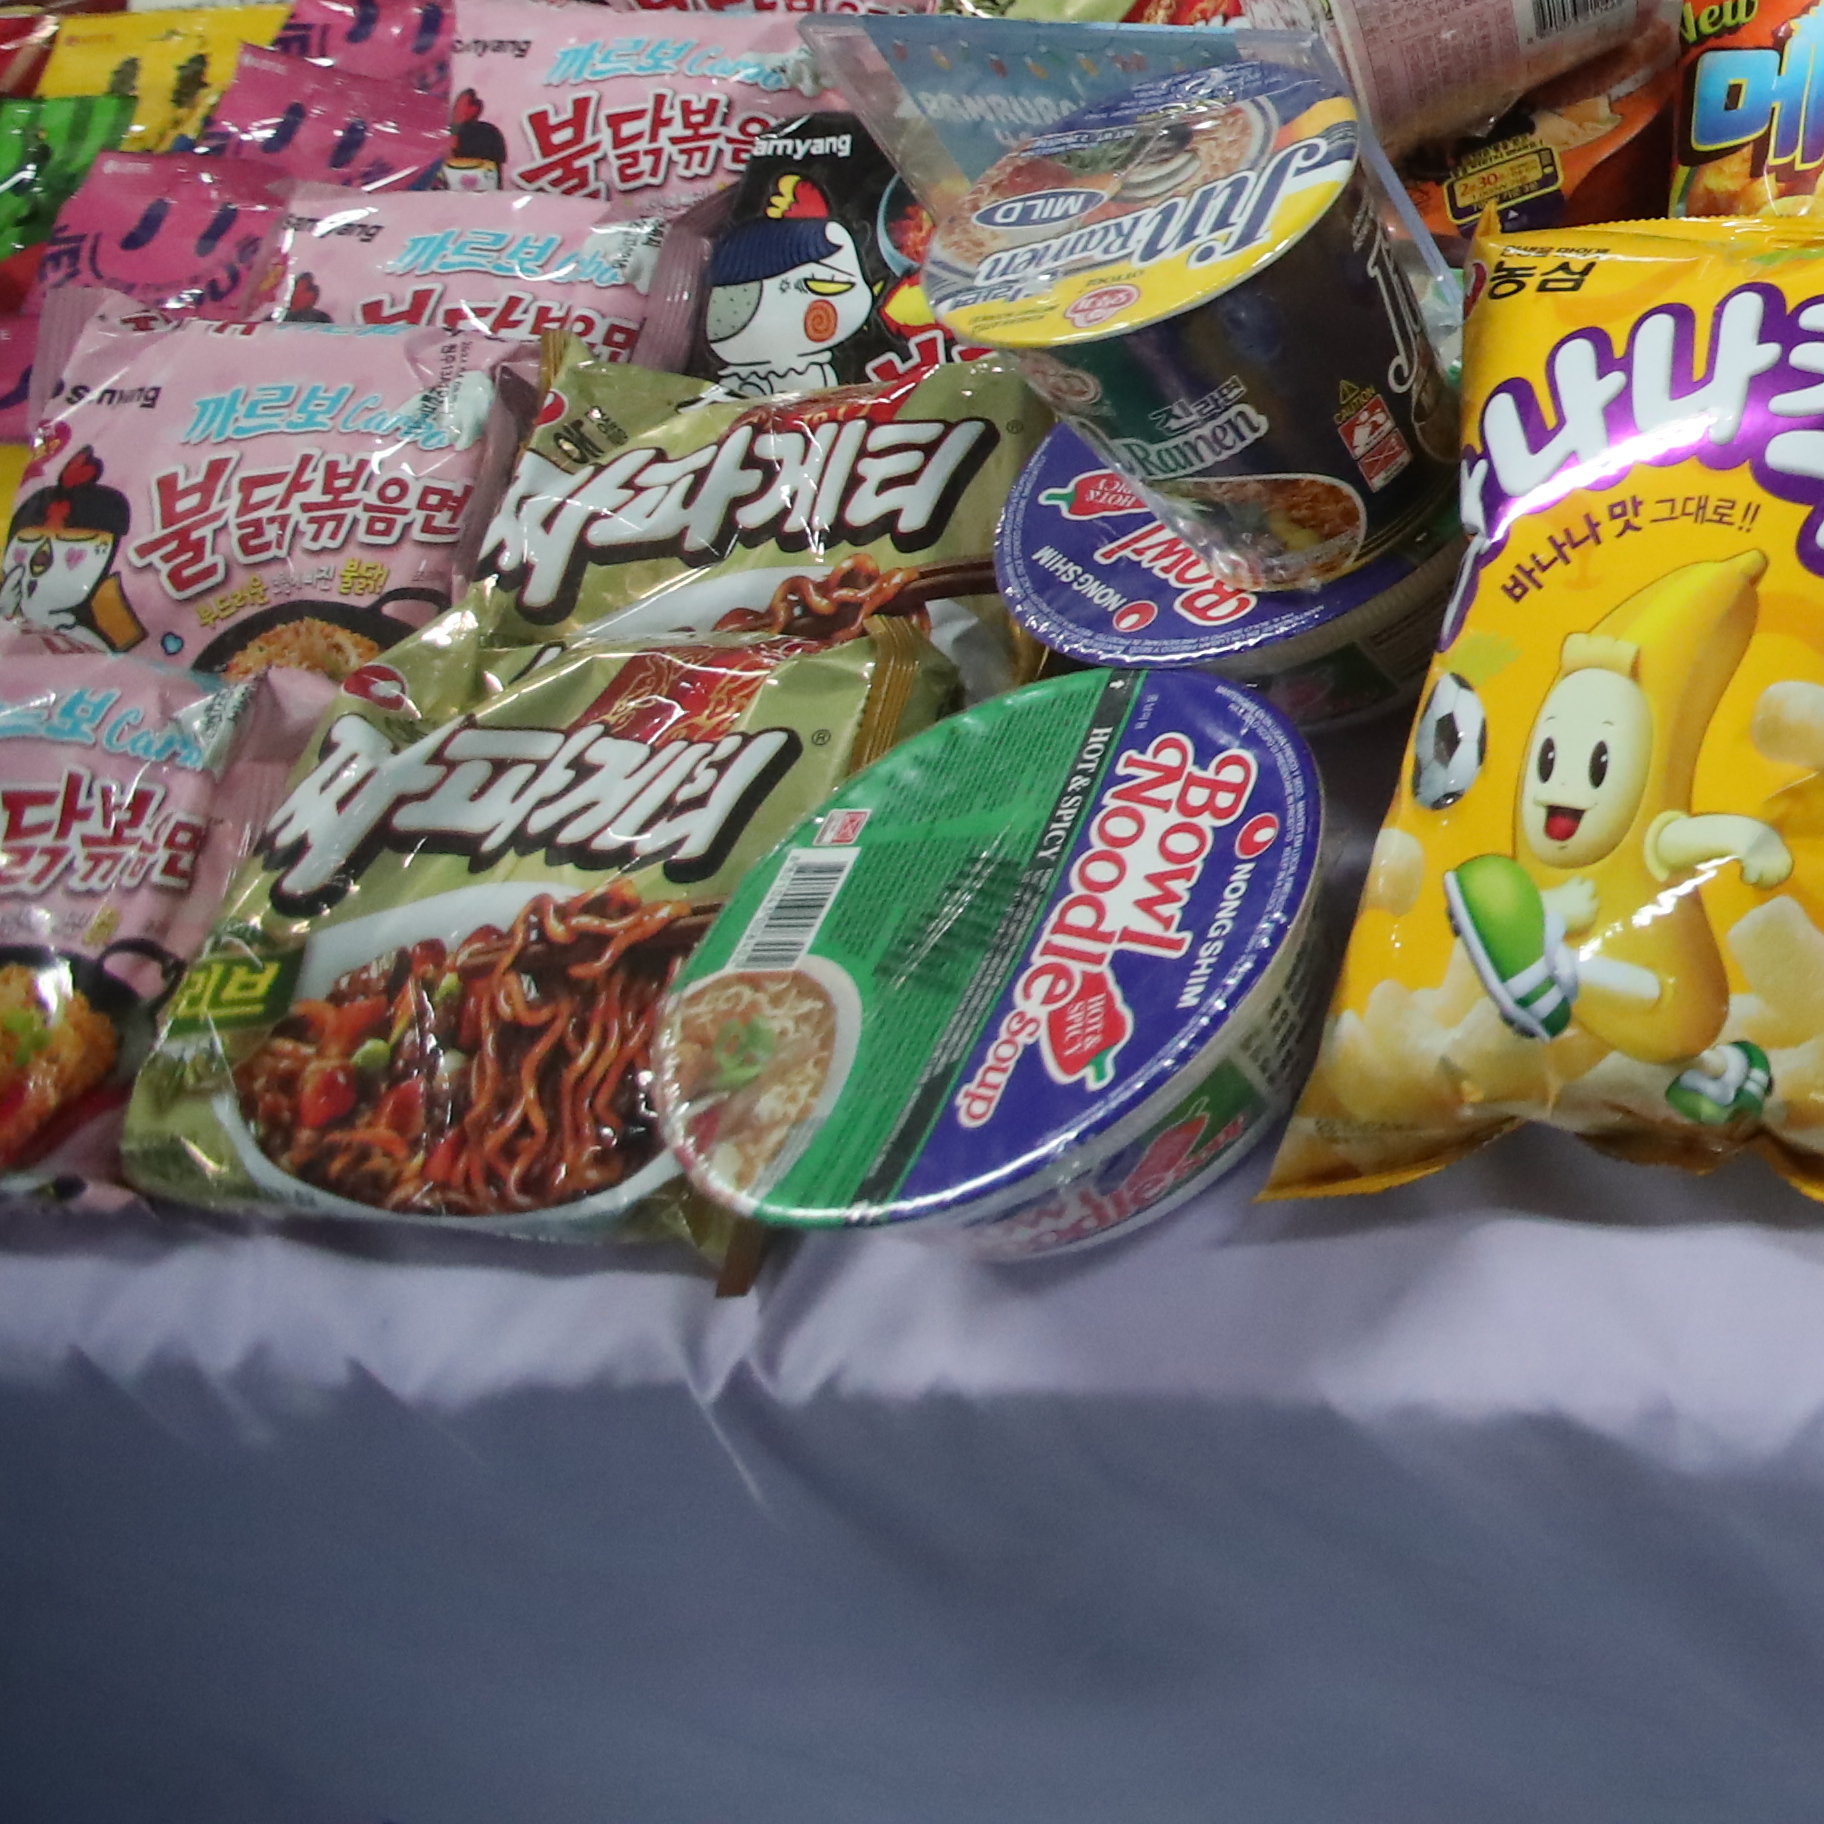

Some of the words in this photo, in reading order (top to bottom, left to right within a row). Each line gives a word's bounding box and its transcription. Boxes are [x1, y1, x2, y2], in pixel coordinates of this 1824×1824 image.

[545, 37, 698, 84] 까르보
[749, 131, 853, 160] amyang
[995, 190, 1087, 223] MILD
[393, 230, 565, 277] 까르보
[971, 215, 1143, 289] Ramen
[1487, 259, 1598, 301] 농심
[182, 383, 345, 443] 까르보
[1126, 403, 1270, 482] Ramen
[130, 446, 474, 605] 불닭볶음면
[486, 420, 983, 608] 짜파게티
[1500, 513, 1602, 603] 바나나
[1606, 496, 1645, 539] 맛
[1650, 496, 1762, 534] 그대로!!
[196, 577, 270, 629] 부드러운
[1086, 723, 1115, 772] HOT
[1035, 793, 1081, 866] SPICY
[1127, 745, 1258, 962] Bowl
[1019, 729, 1200, 1024] Noodle
[956, 1008, 1045, 1131] Soup
